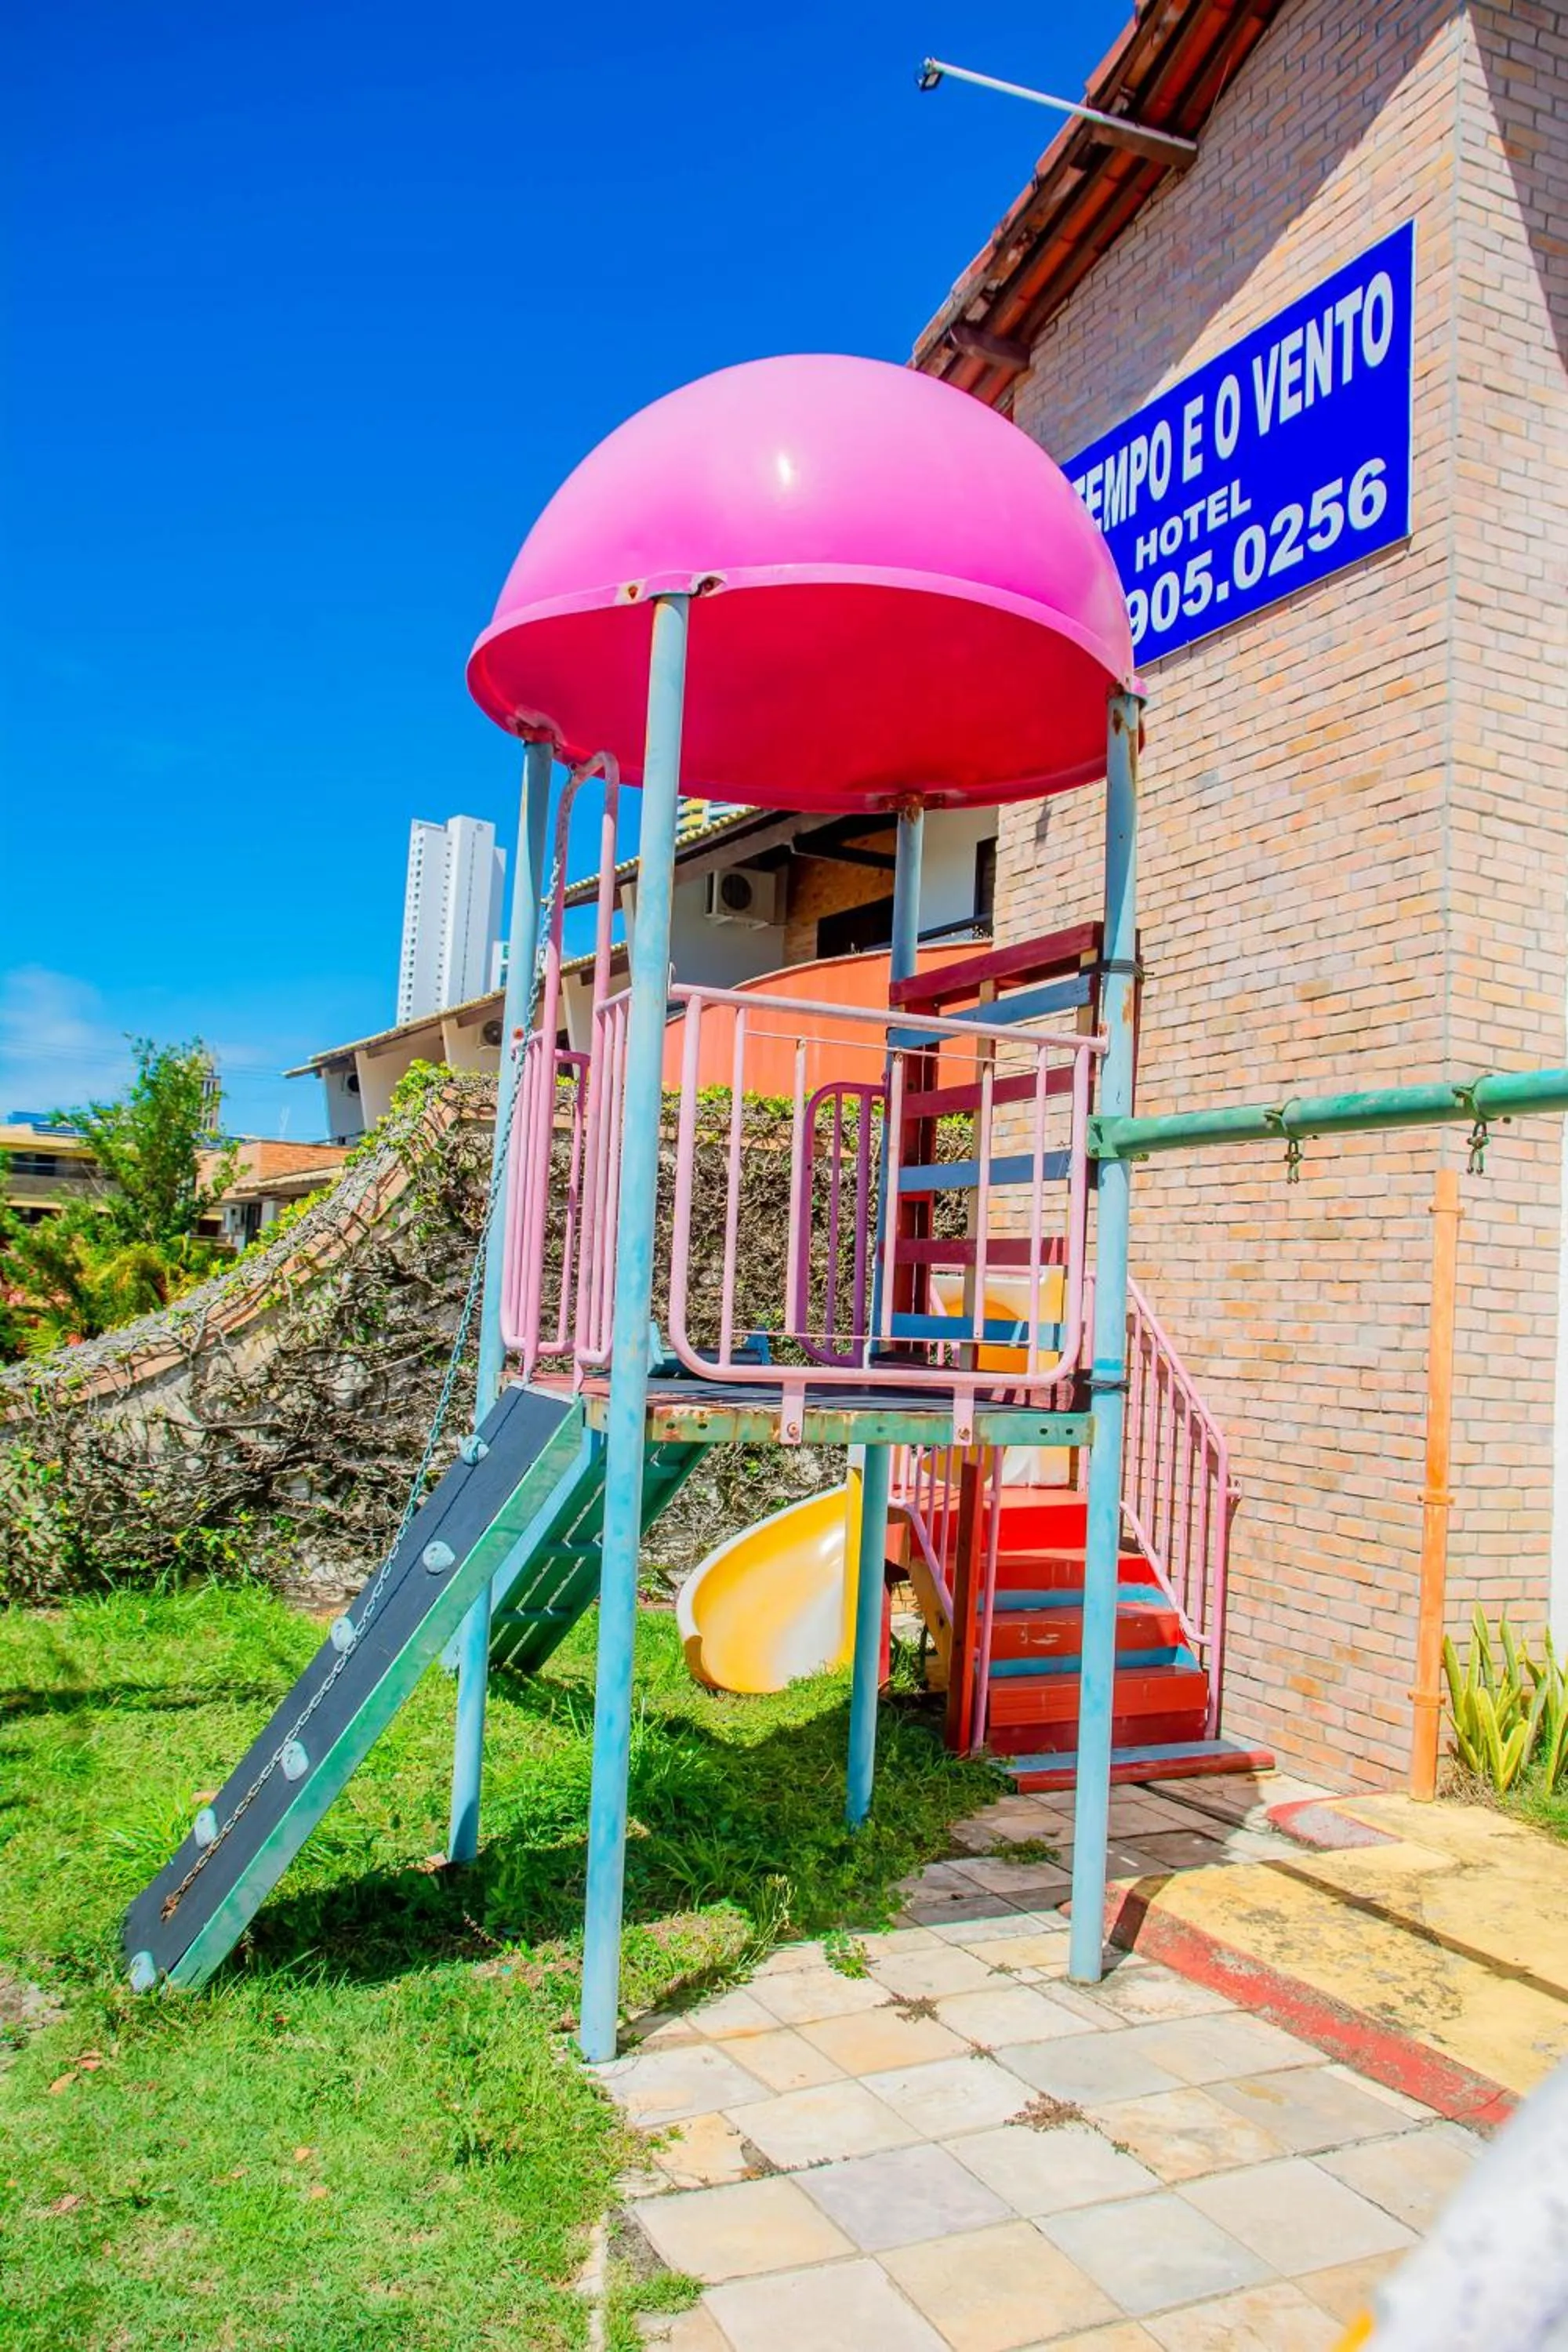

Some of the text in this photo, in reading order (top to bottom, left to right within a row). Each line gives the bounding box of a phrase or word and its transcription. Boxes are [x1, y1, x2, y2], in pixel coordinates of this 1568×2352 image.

[1072, 271, 1393, 532] EMPO E O VENTO
[1126, 458, 1387, 646] 905.0256
[1135, 479, 1251, 572] HOTEL
